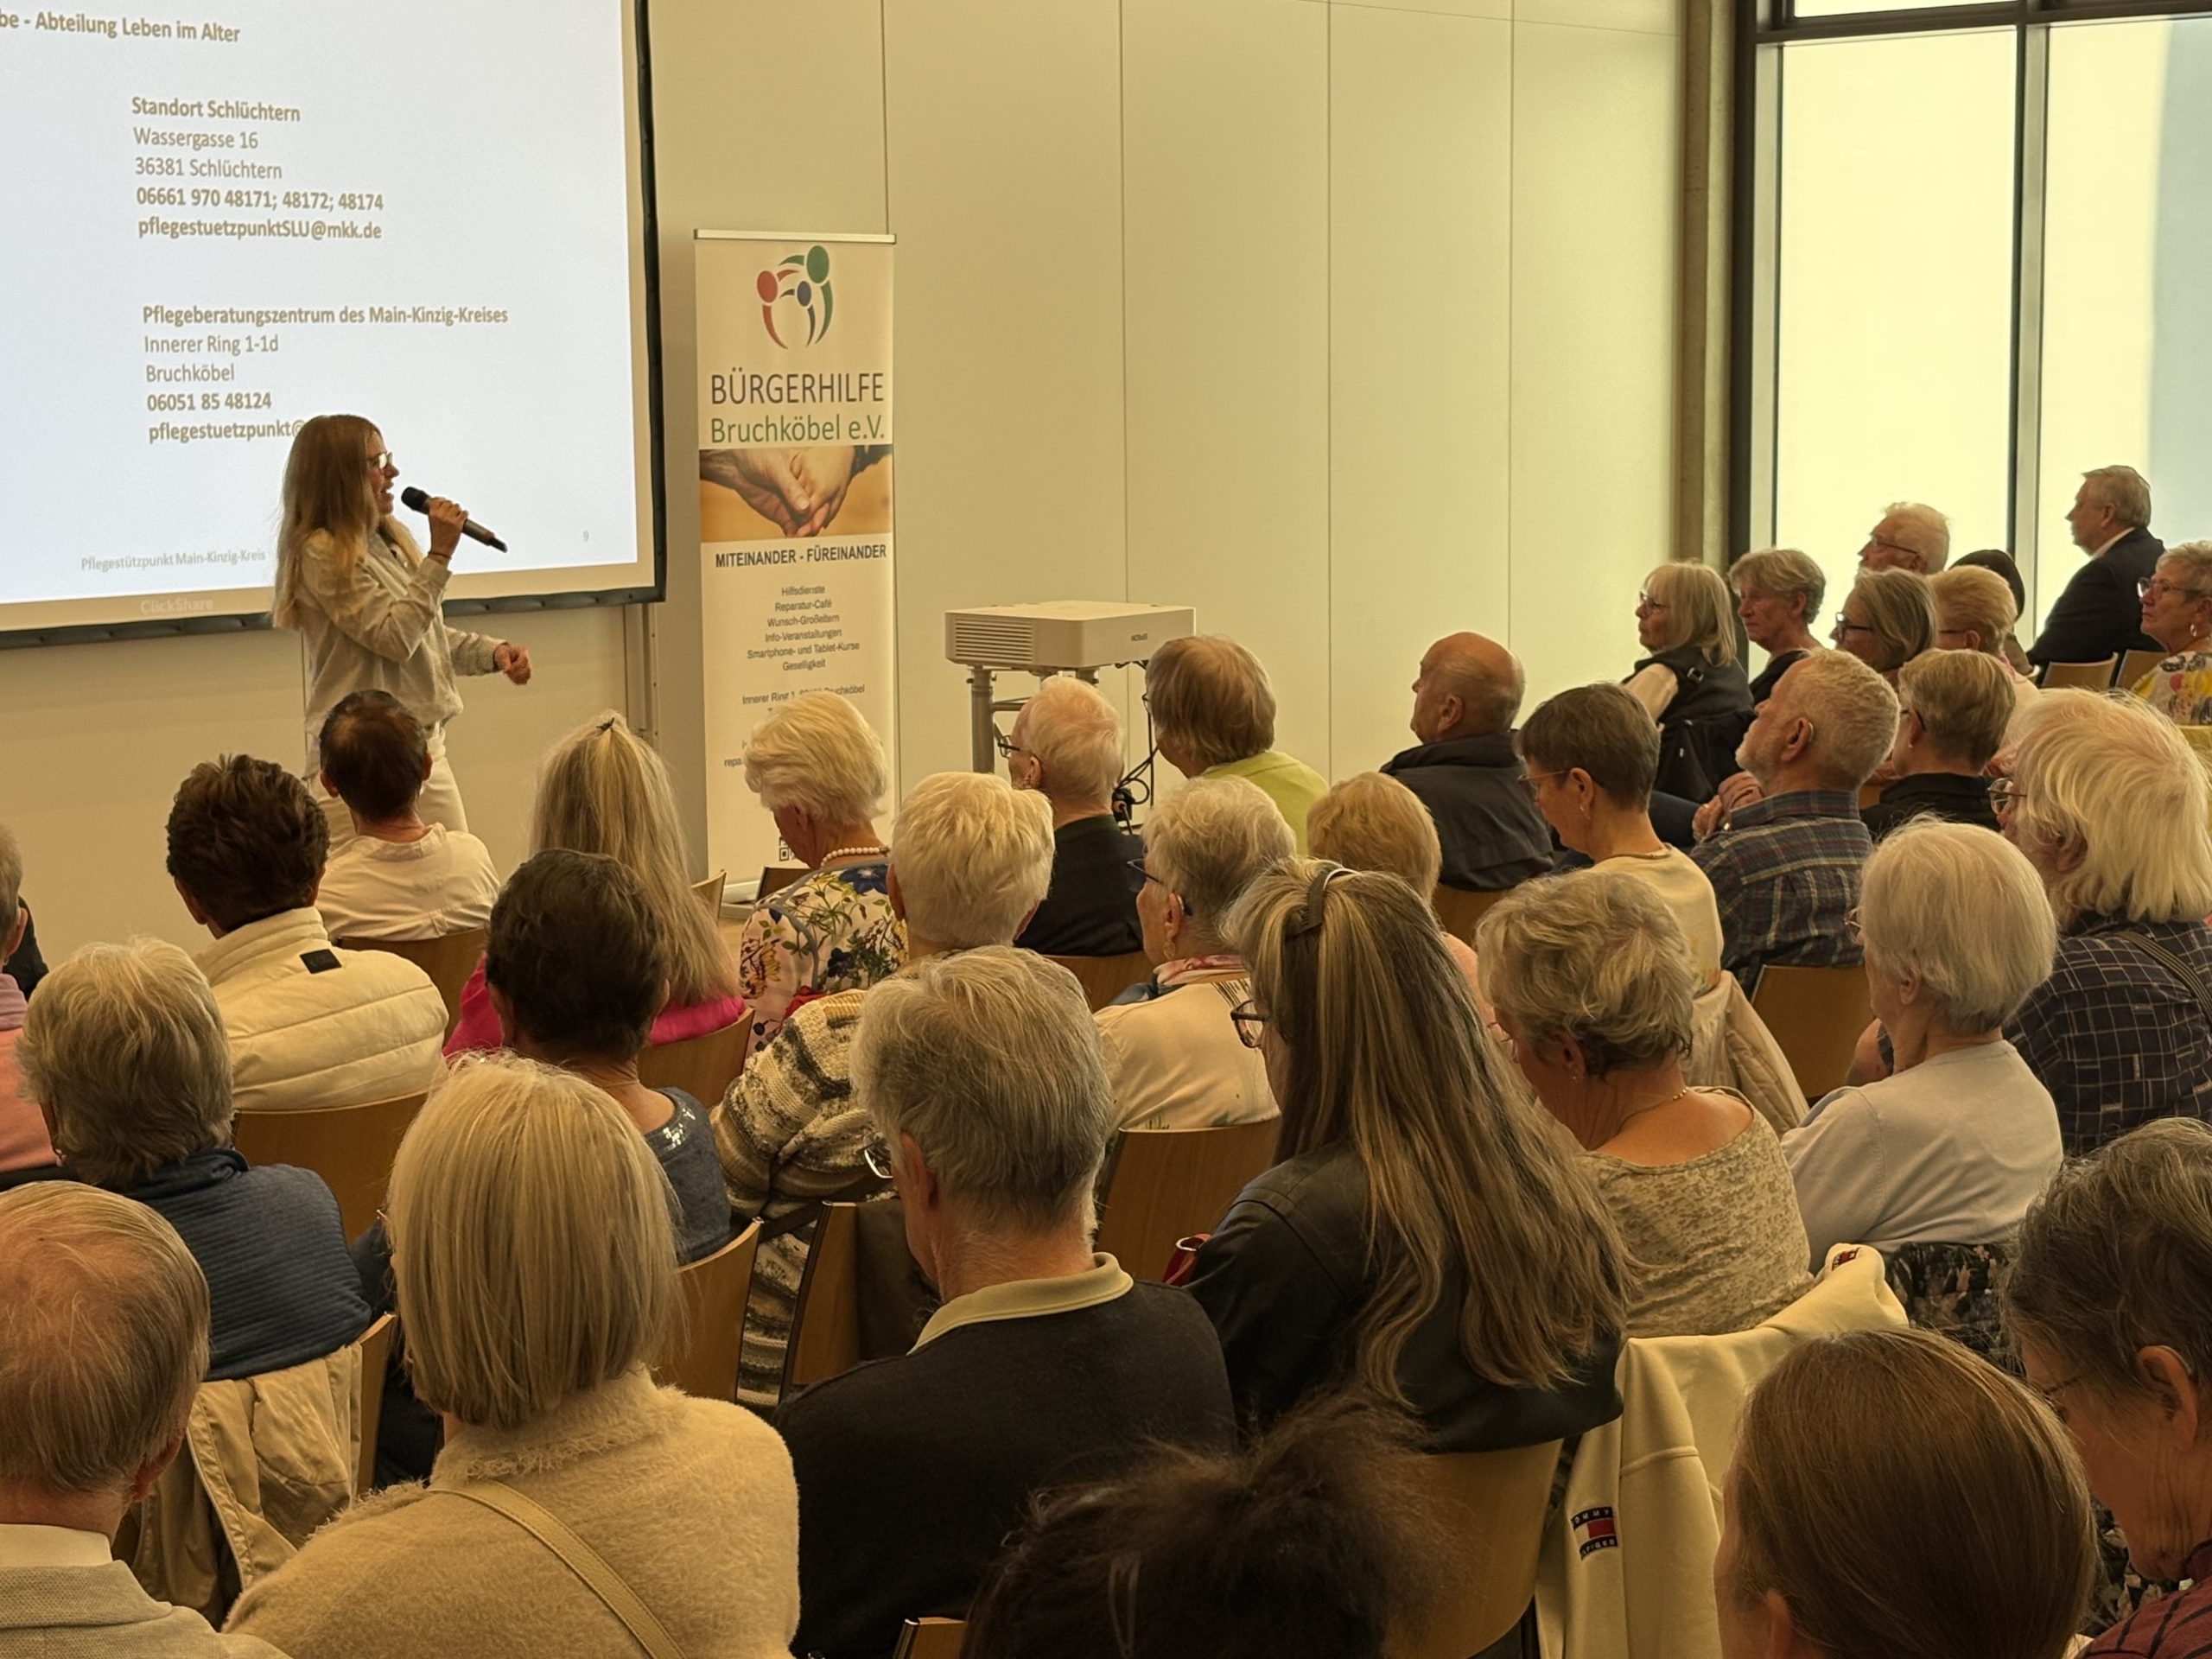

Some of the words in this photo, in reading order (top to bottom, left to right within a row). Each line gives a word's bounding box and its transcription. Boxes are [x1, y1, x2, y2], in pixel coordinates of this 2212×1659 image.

[0, 8, 19, 29] be
[35, 11, 118, 39] Abteilung
[122, 16, 172, 38] Leben
[175, 20, 197, 40] im
[201, 22, 240, 43] Alter
[131, 96, 203, 118] Standort
[207, 99, 301, 123] Schlüchtern
[132, 127, 235, 151] Wassergasse
[238, 130, 259, 149] 16
[135, 156, 185, 176] 36381
[189, 158, 283, 180] Schlüchtern
[137, 187, 186, 205] 06661
[190, 188, 220, 207] 970
[224, 189, 277, 211] 48171;
[282, 191, 334, 213] 48172;
[338, 193, 385, 211] 48174
[138, 216, 383, 241] pflegestuetzpunktSLU@mkk.de
[142, 305, 335, 327] Pflegeberatungszentrum
[339, 305, 365, 324] des
[368, 305, 509, 327] Main-Kinzig-Kreises
[143, 334, 204, 353] Innerer
[207, 334, 241, 356] Ring
[245, 334, 279, 353] 1-1d
[145, 363, 235, 383] Bruchköbel
[711, 367, 884, 404] BÜRGERHILFE
[147, 393, 195, 411] 06051
[200, 393, 220, 410] 85
[225, 391, 272, 410] 48124
[711, 414, 840, 443] Bruchköbel
[849, 415, 885, 439] e.V.
[583, 530, 589, 543] 9
[81, 554, 174, 573] Pflegestützpunkt
[175, 549, 266, 567] Main-Kinzig-Kreis
[715, 549, 797, 568] MITEINANDER
[807, 544, 887, 563] FÜREINANDER
[781, 586, 825, 596] Hilfsdienste
[140, 598, 214, 614] ClickShare
[775, 599, 832, 612] Reparatur-Café
[765, 628, 842, 642] Info-Veranstaltungen
[798, 645, 812, 655] und
[814, 642, 860, 653] Tablet-Kurse
[783, 659, 826, 671] Geselligkeit
[742, 695, 769, 704] Innerer
[1574, 1509, 1609, 1524] OMMY
